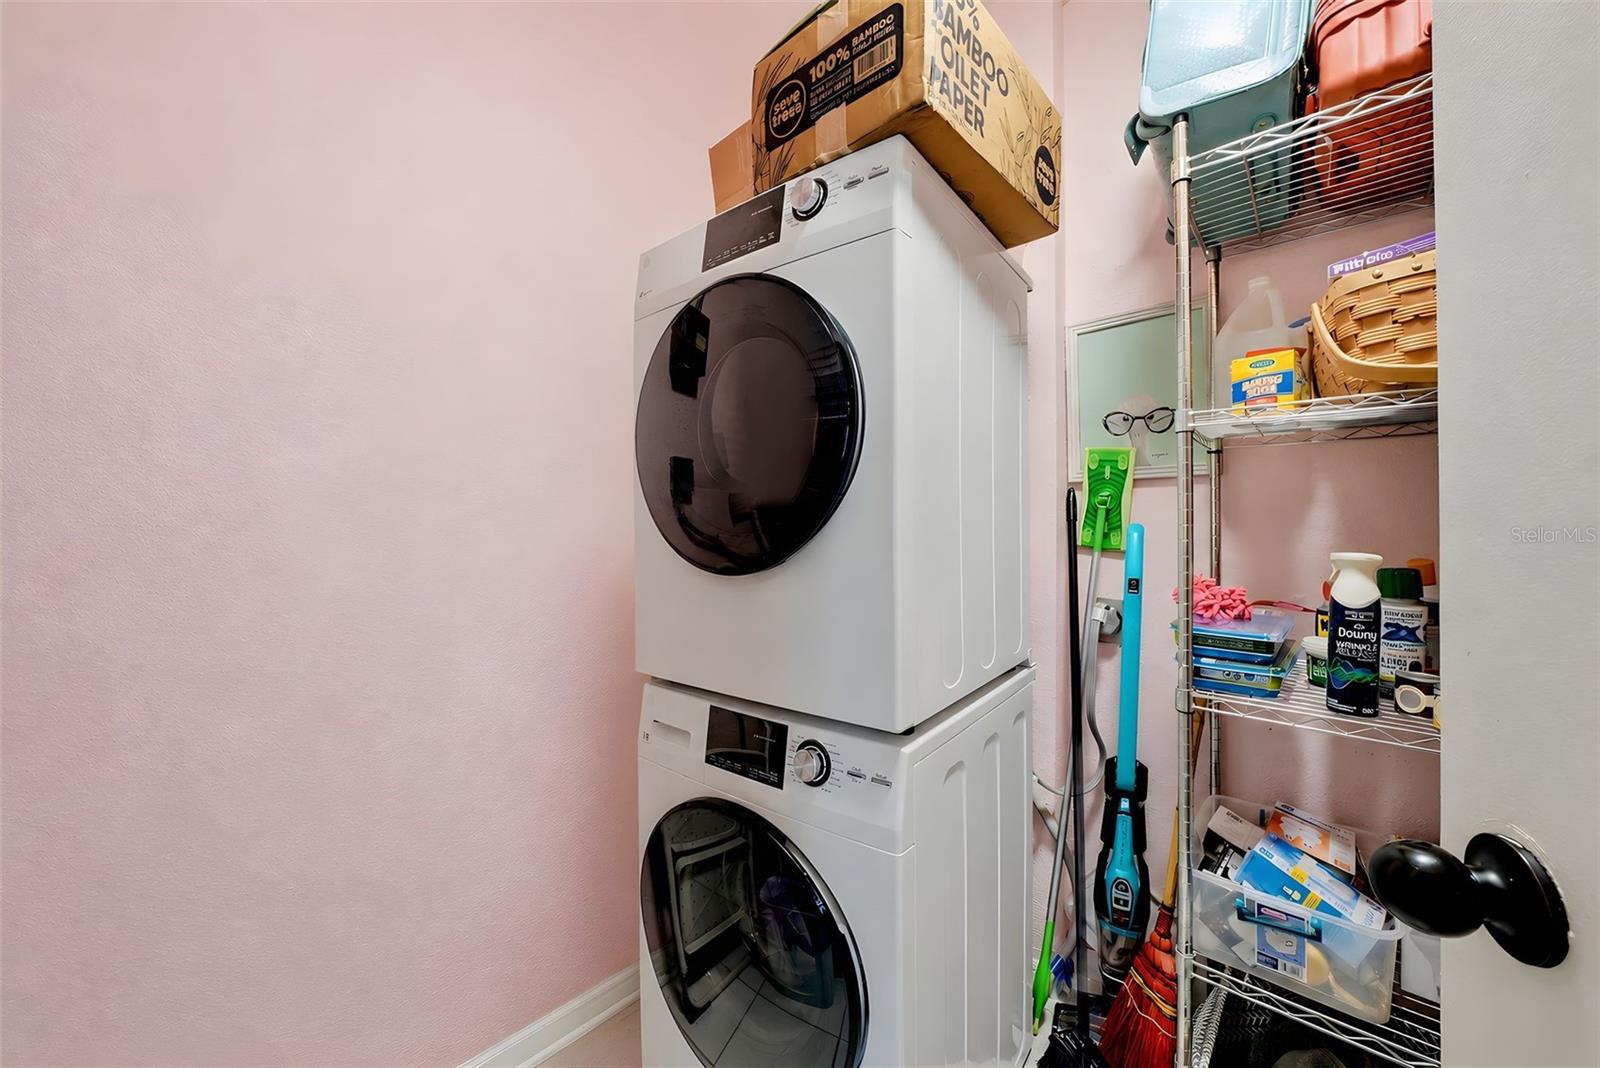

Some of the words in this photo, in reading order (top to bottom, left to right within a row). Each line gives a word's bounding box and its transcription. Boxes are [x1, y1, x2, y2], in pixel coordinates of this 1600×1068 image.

[809, 45, 851, 83] 100%
[851, 13, 895, 47] BAMBOO
[929, 56, 984, 138] PAPER
[1338, 626, 1377, 643] Downy
